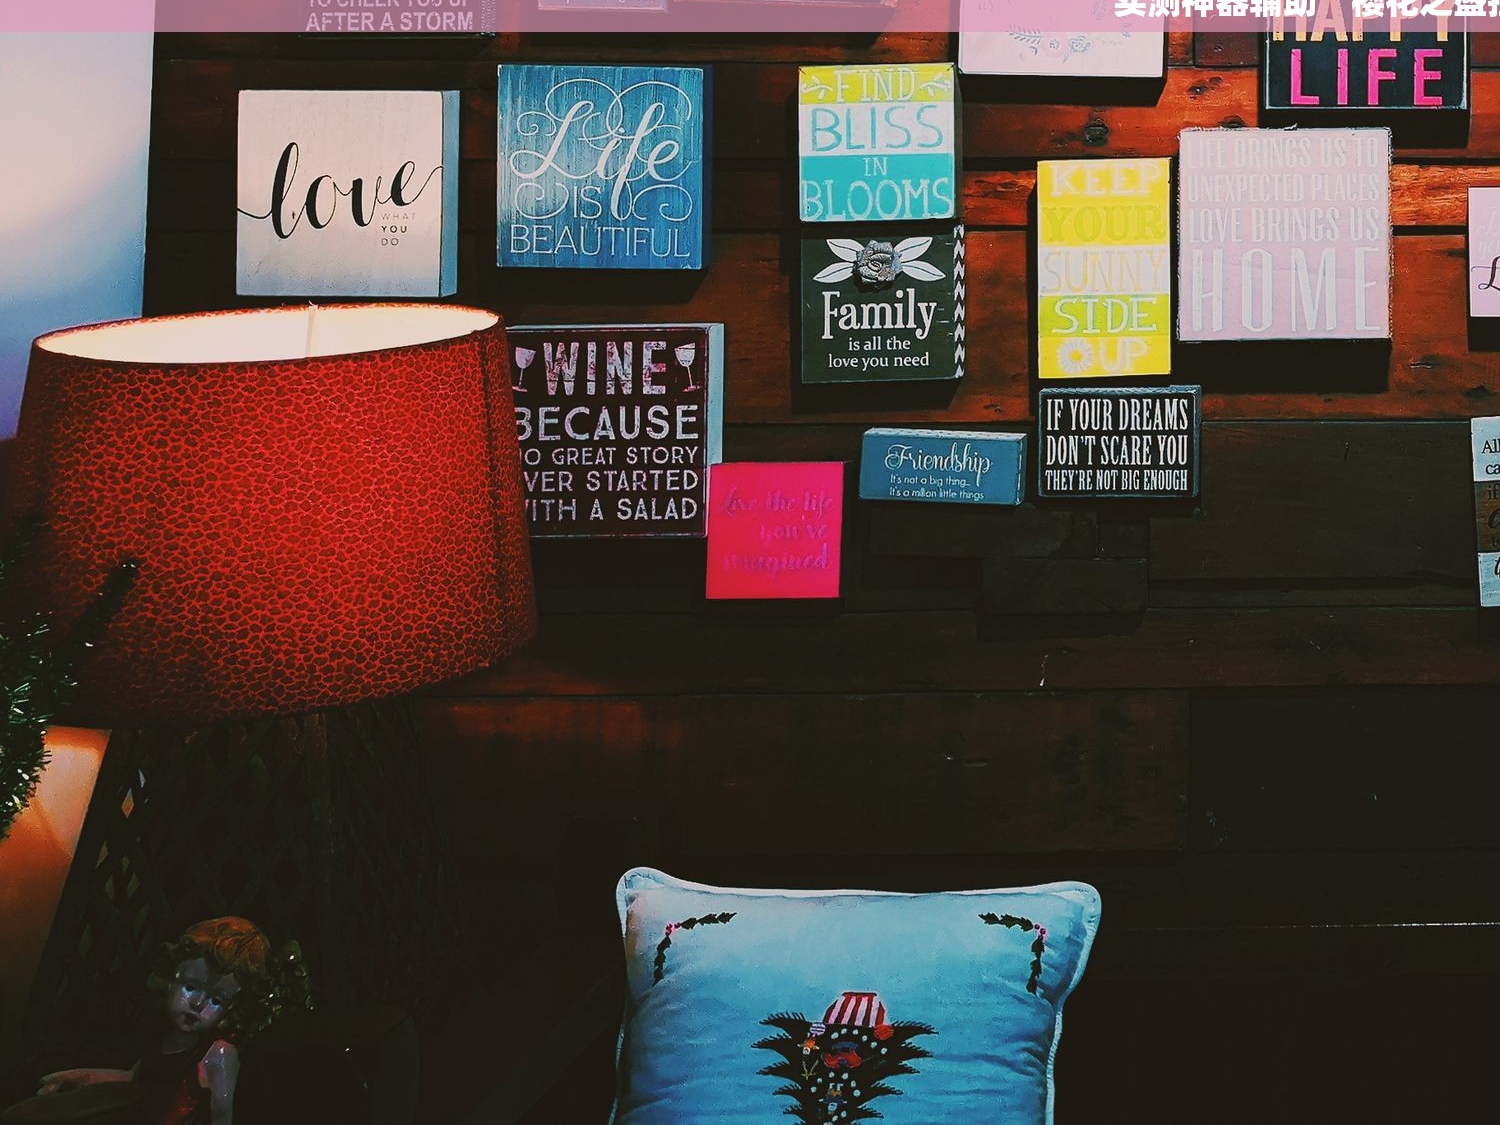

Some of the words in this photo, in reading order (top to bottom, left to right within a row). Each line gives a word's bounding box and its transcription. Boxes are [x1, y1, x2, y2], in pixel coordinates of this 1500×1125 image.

[1290, 49, 1442, 106] LIFE
[810, 104, 943, 152] BLISS
[803, 178, 954, 221] BLOOMS
[509, 226, 690, 259] BEAUTIFUL
[1191, 247, 1381, 335] HOME
[821, 290, 938, 341] Family
[1051, 296, 1157, 334] SIDE
[543, 342, 666, 395] WINE
[829, 353, 858, 367] love
[861, 355, 890, 371] you
[893, 352, 929, 366] need
[1047, 398, 1061, 431] IF
[1070, 398, 1113, 431] YOUR
[1119, 398, 1188, 430] DREAMS
[885, 442, 993, 487] Friendship
[1047, 435, 1096, 467] DON'T
[1101, 435, 1153, 465] SCARE
[1157, 435, 1188, 464] YOU
